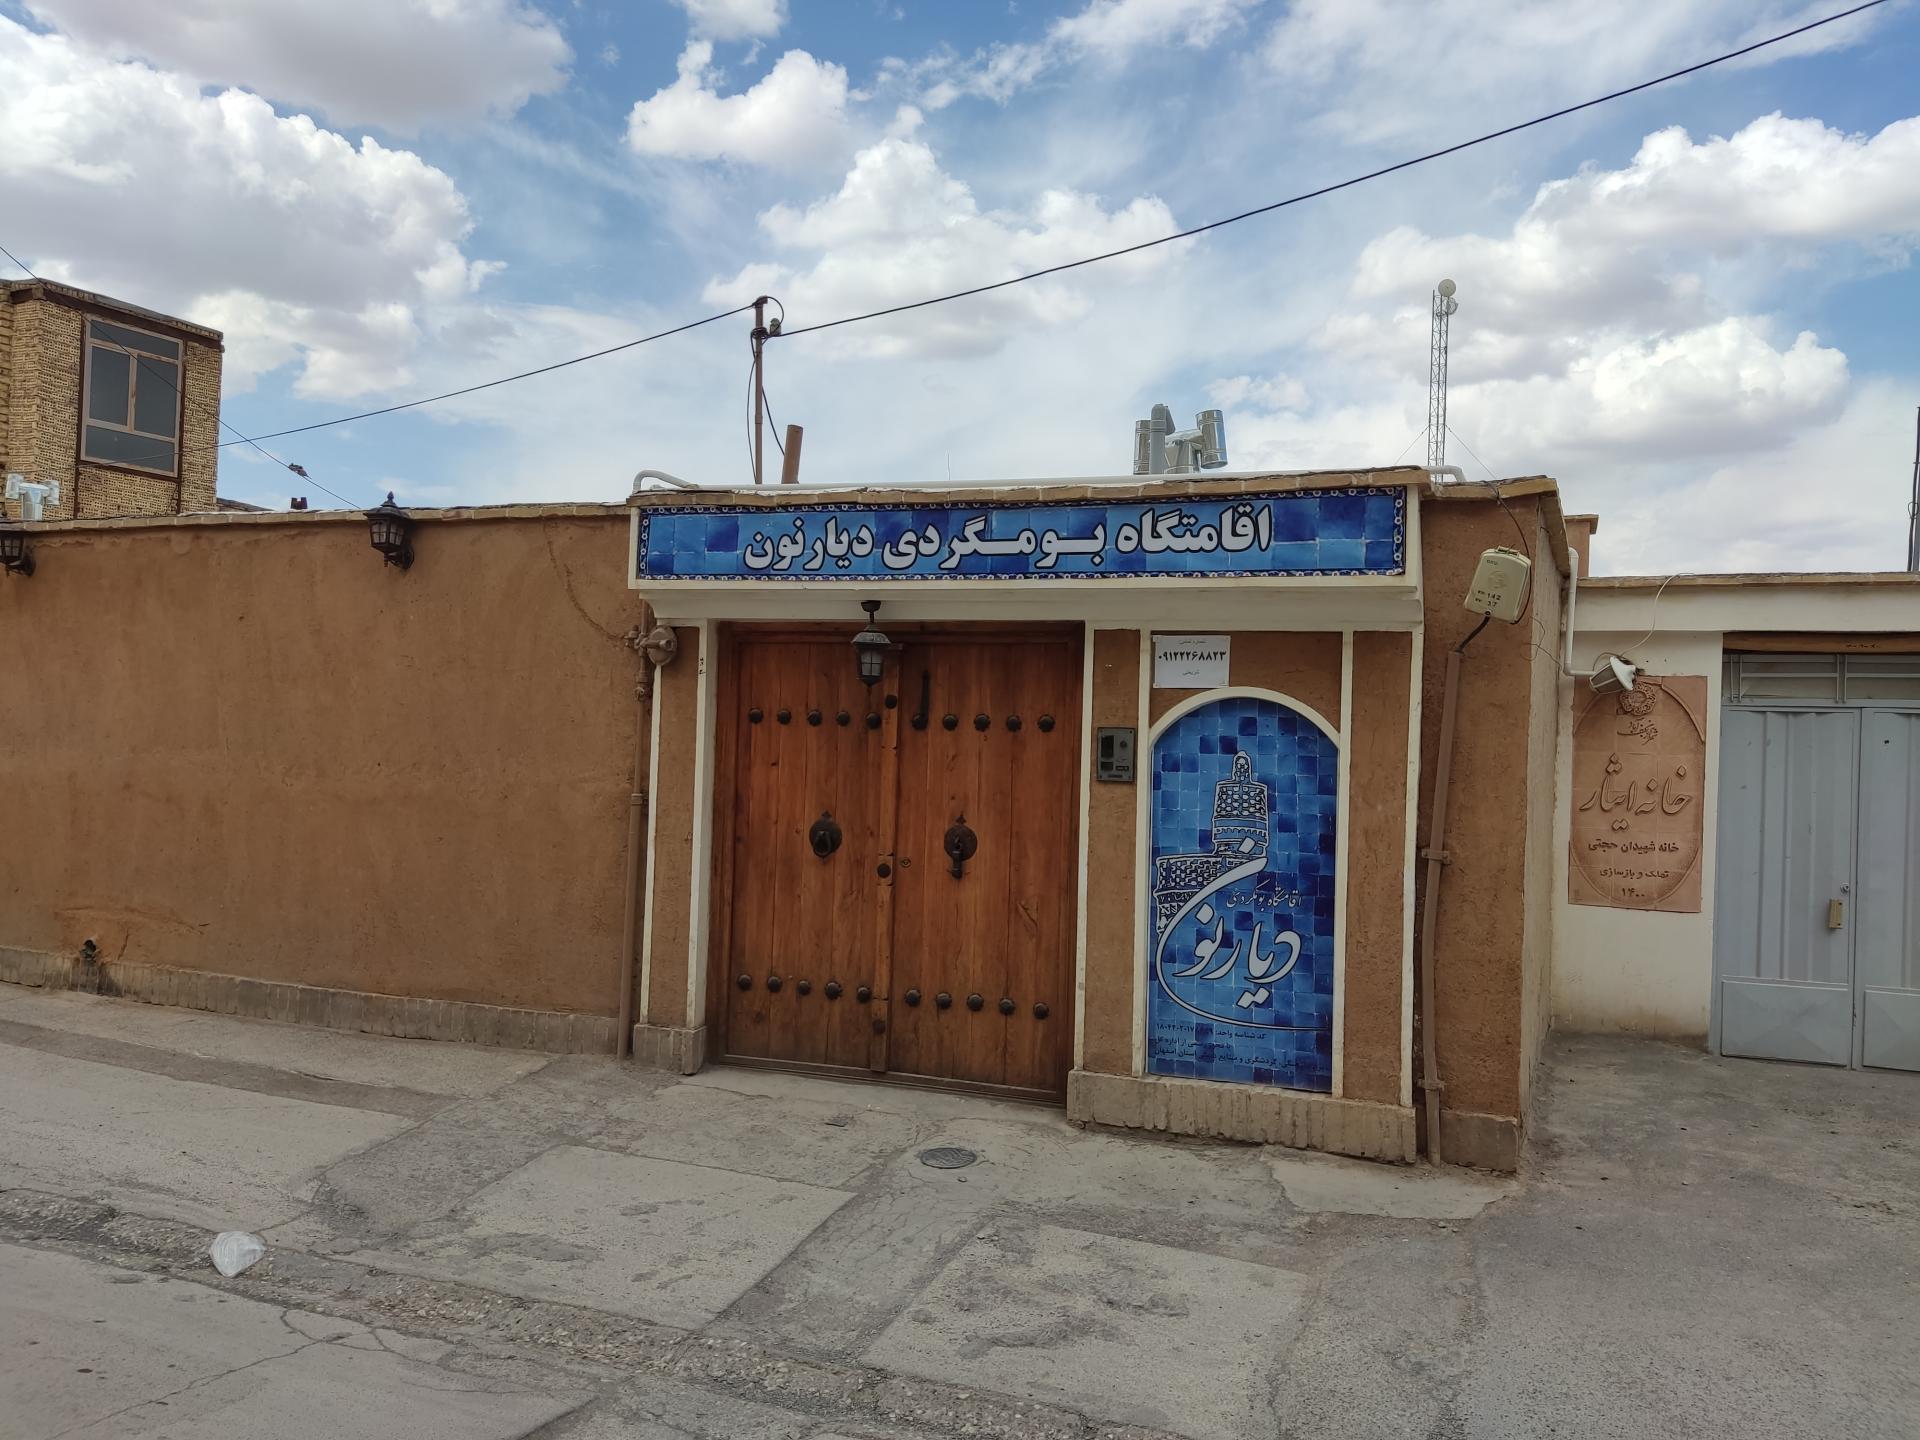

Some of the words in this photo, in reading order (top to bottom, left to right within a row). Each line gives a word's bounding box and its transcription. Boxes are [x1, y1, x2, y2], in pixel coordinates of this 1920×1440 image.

[1115, 503, 1272, 554] اقامتگاه
[1579, 752, 1637, 832] ایثار
[1635, 765, 1693, 816] خانه
[1588, 838, 1618, 853] حجتی
[1620, 841, 1656, 855] شهیدان
[1658, 842, 1680, 853] خانه
[1600, 867, 1636, 880] بازسازی
[1636, 870, 1644, 880] و
[1267, 887, 1302, 908] اقامتگاه
[1621, 886, 1646, 898] ۱۴۰۰
